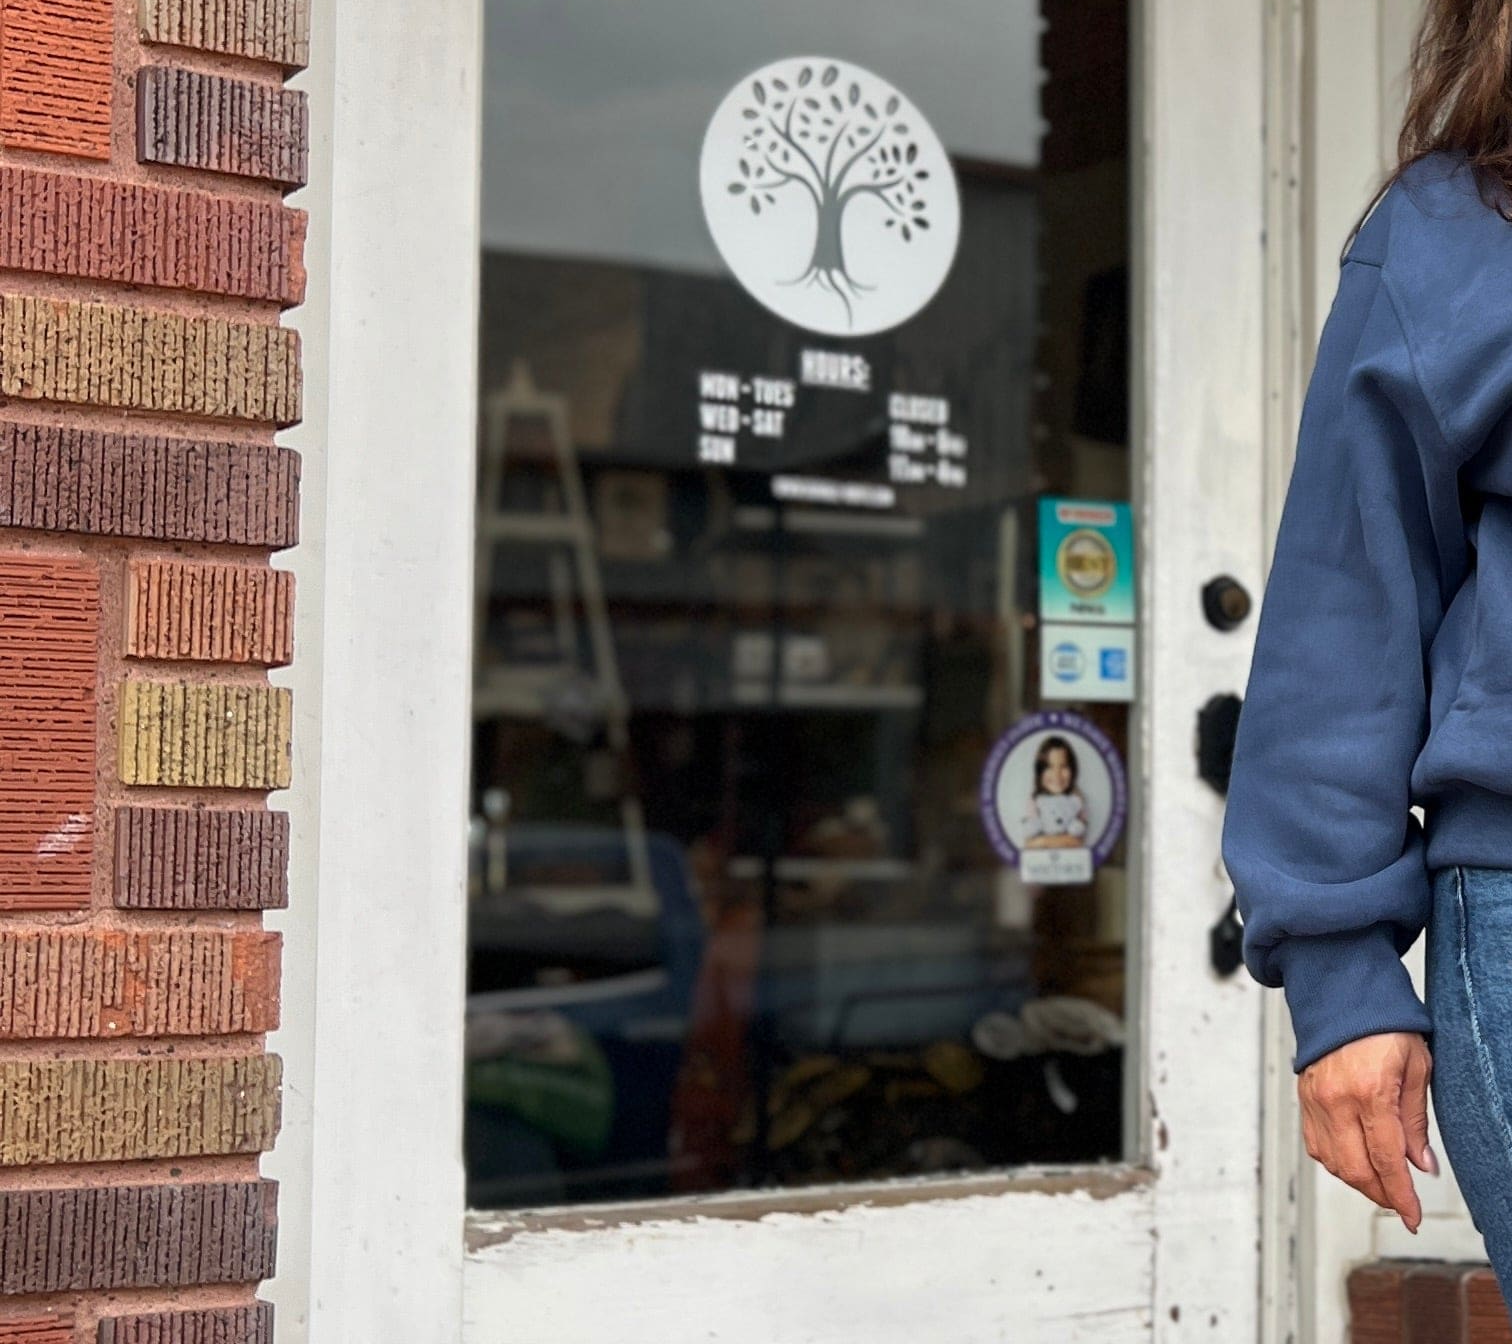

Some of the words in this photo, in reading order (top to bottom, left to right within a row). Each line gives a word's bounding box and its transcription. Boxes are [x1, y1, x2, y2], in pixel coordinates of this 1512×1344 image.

[699, 372, 739, 401] MON
[752, 376, 796, 408] TUES
[699, 403, 739, 433] WED
